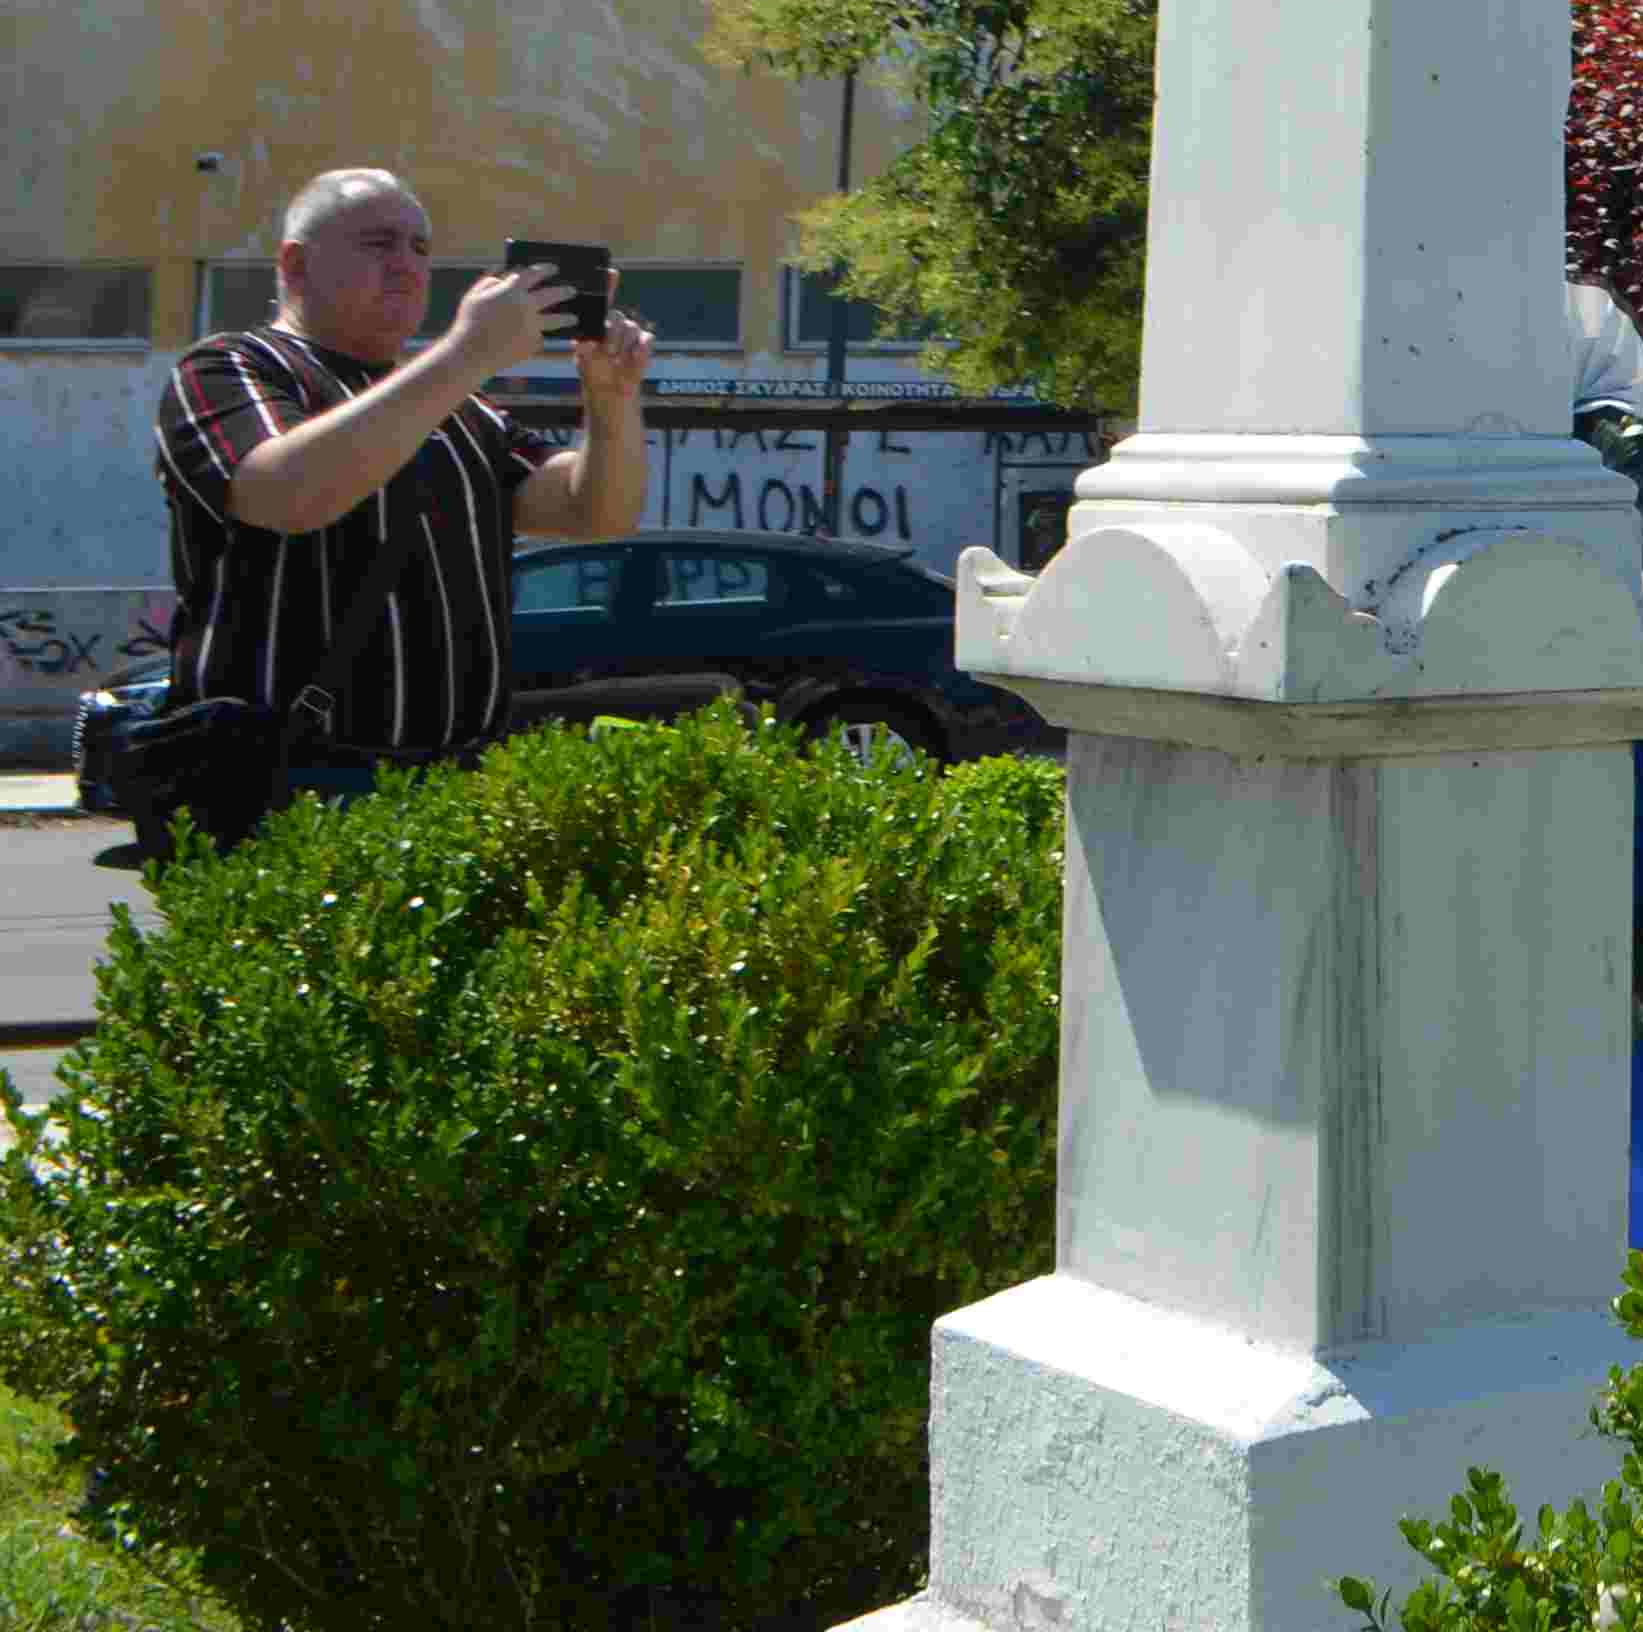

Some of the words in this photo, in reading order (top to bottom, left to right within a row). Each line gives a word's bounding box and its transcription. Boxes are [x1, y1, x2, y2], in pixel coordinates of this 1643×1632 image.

[657, 381, 729, 394] ΔΗΜΟΣ
[735, 382, 826, 396] ΣΚΥΔΡΑΣ
[841, 383, 955, 397] ΚΟΙΝΟΤΗΤΑ
